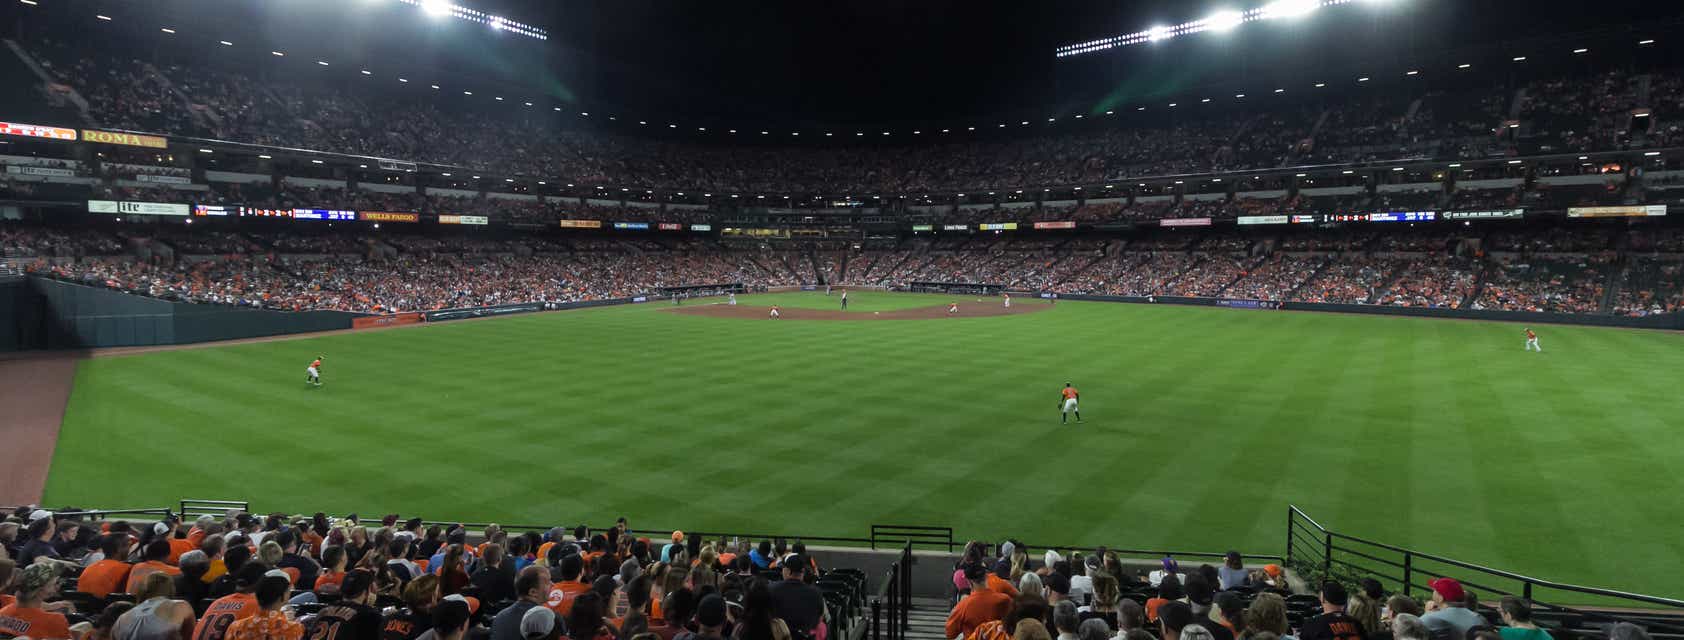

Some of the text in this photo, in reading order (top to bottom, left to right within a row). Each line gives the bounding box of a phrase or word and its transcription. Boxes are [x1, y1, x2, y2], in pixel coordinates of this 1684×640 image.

[83, 130, 142, 145] ROMA
[199, 612, 236, 640] 19
[310, 621, 341, 640] 21
